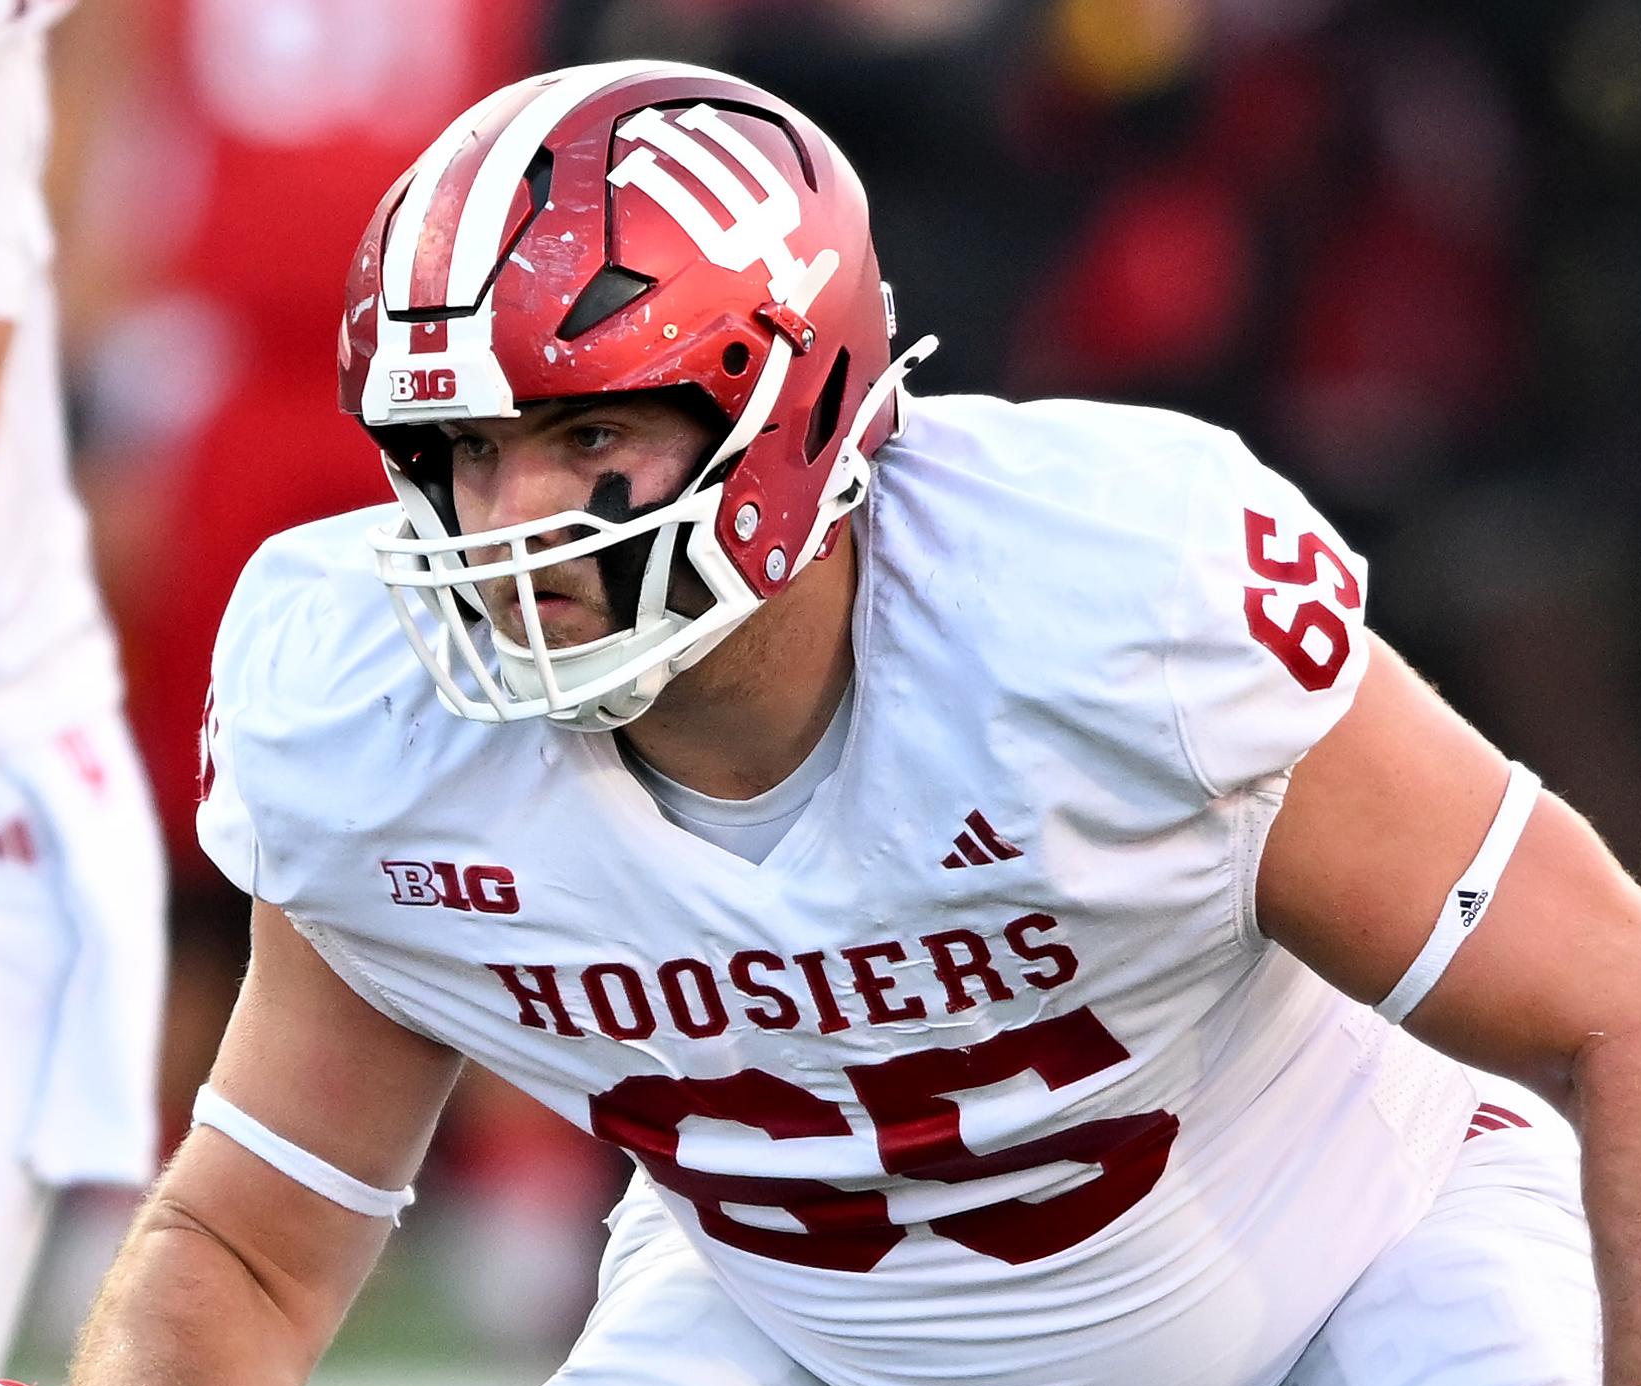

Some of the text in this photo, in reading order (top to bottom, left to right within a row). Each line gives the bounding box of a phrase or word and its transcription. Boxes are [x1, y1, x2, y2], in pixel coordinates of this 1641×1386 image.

[1244, 508, 1360, 691] 65
[488, 912, 1080, 1040] HOOSIERS
[1463, 889, 1489, 928] adidas
[590, 1007, 1179, 1273] 65
